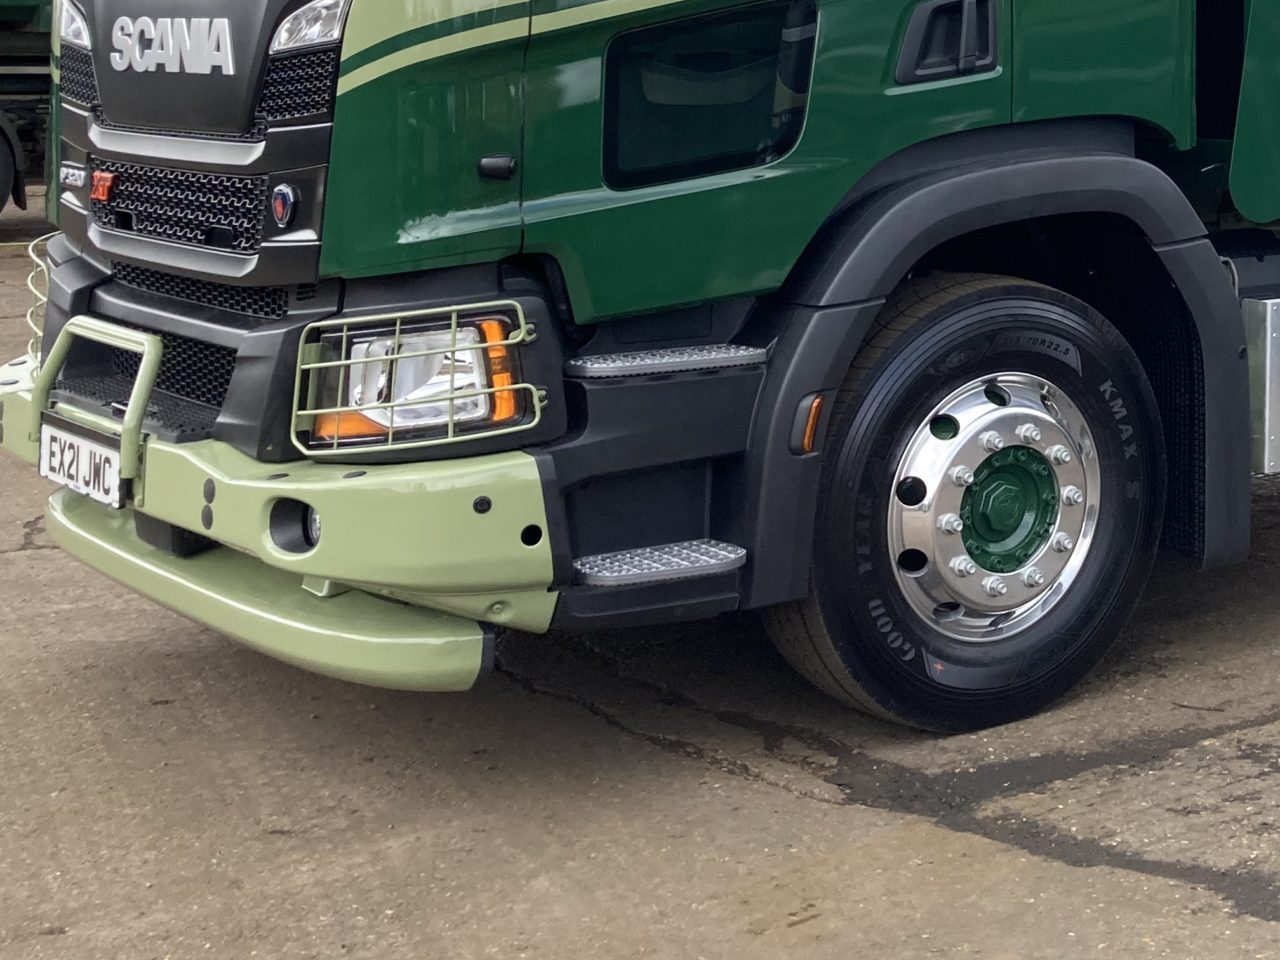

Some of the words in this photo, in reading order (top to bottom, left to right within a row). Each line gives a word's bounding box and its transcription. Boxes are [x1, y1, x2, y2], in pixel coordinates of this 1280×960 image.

[110, 16, 235, 75] SCANIA
[60, 167, 85, 187] P320
[91, 171, 114, 201] XT
[1099, 379, 1138, 460] KMAX
[49, 435, 80, 483] EX21
[83, 450, 112, 496] JWC
[868, 598, 916, 661] GOOD
